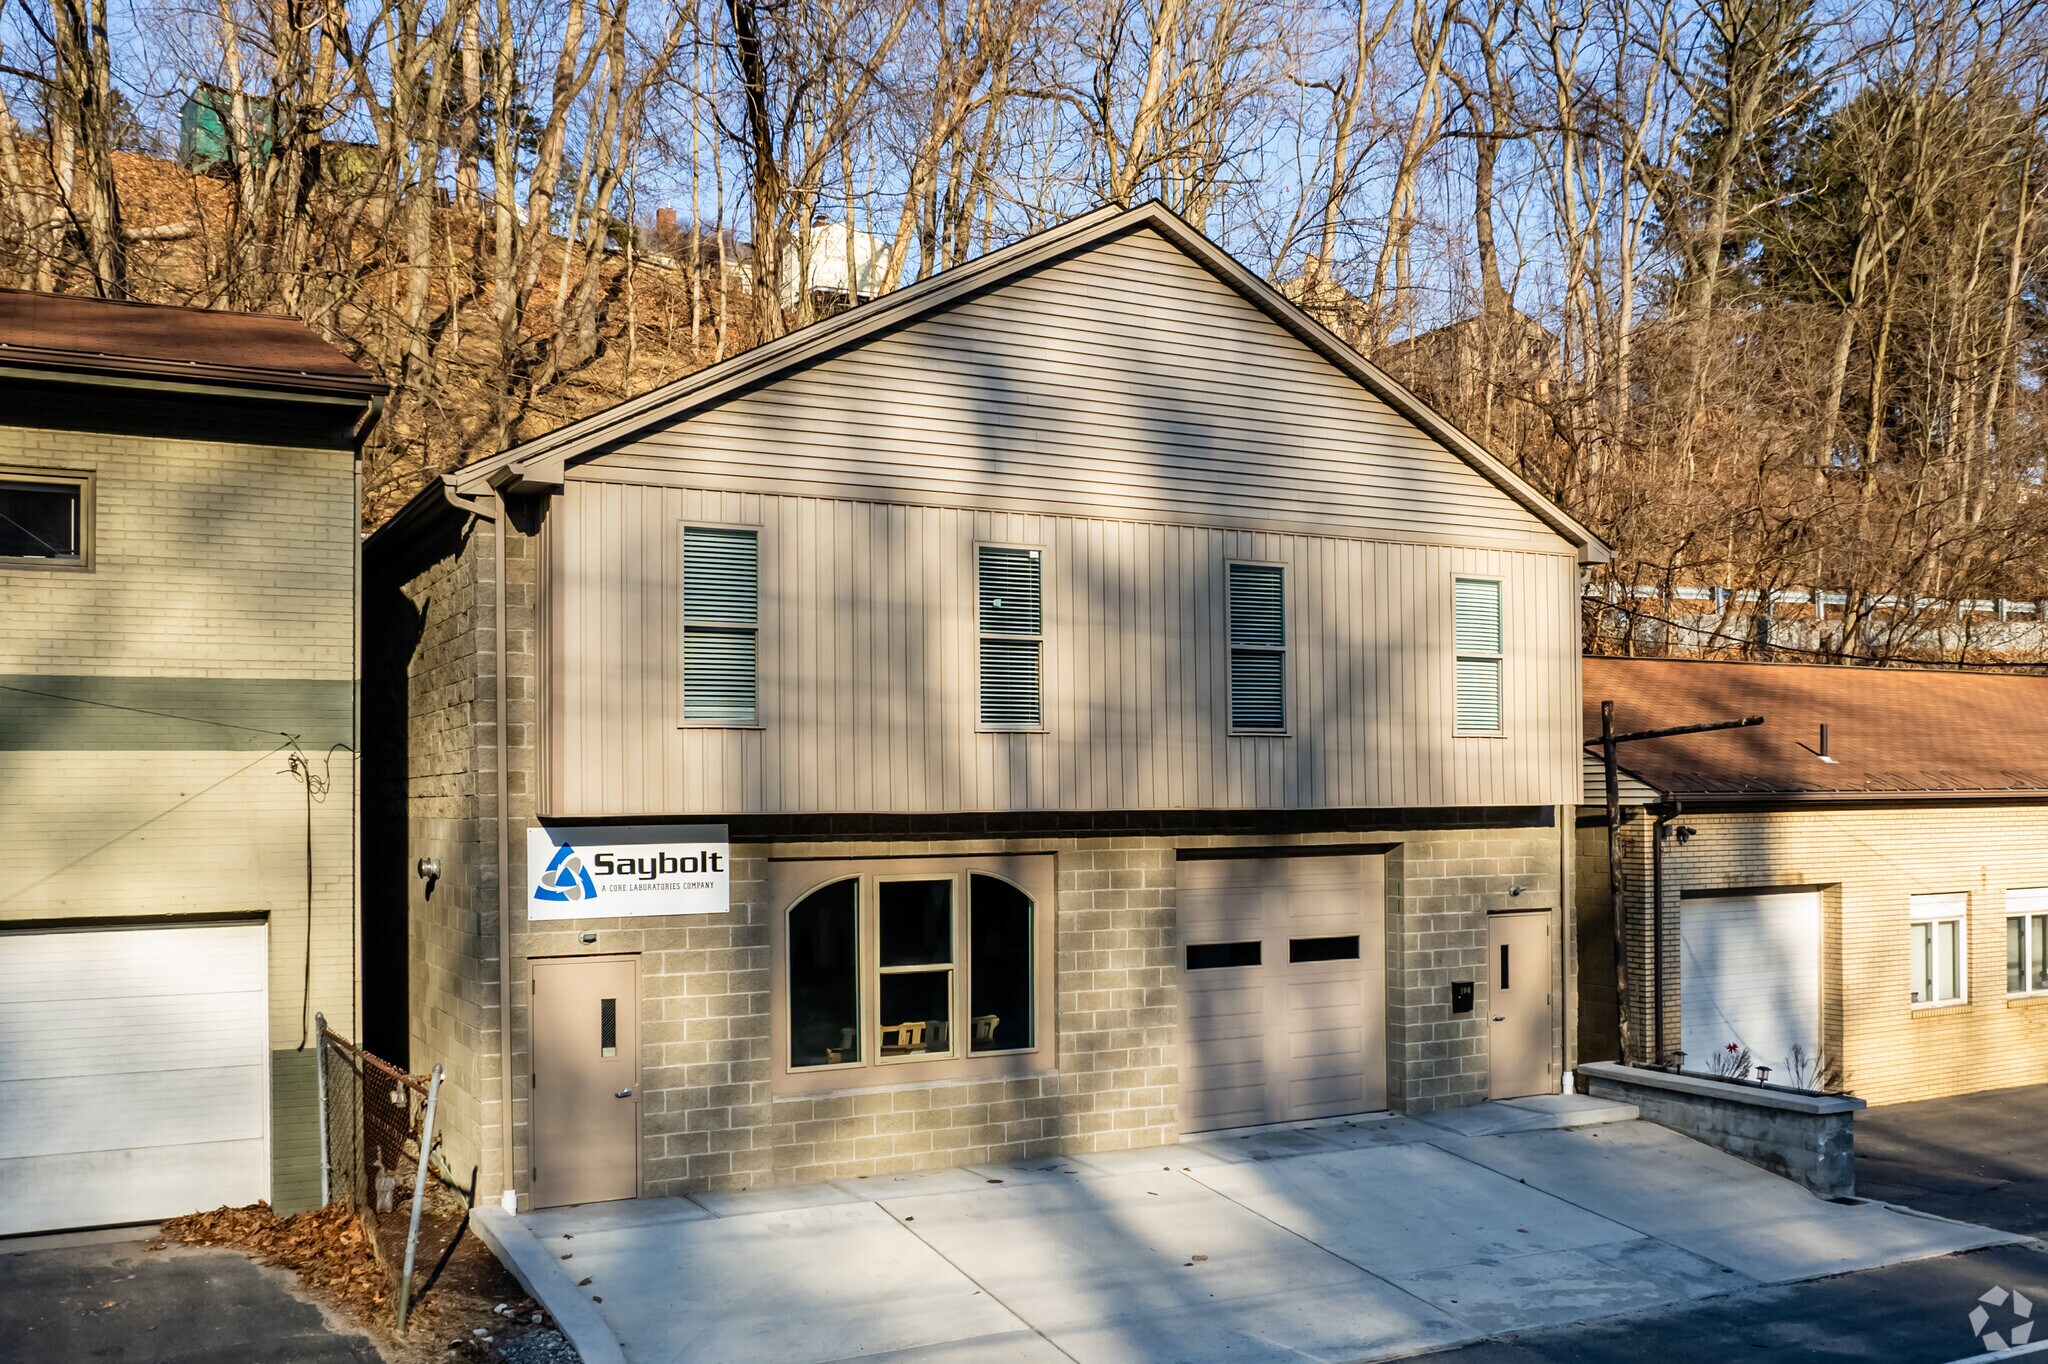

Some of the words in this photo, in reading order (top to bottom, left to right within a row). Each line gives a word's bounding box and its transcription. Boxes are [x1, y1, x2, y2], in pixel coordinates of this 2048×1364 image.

[594, 851, 724, 880] Saybolt
[609, 884, 627, 892] CORE
[629, 882, 681, 892] LABORATORIES
[683, 881, 715, 890] COMPANY
